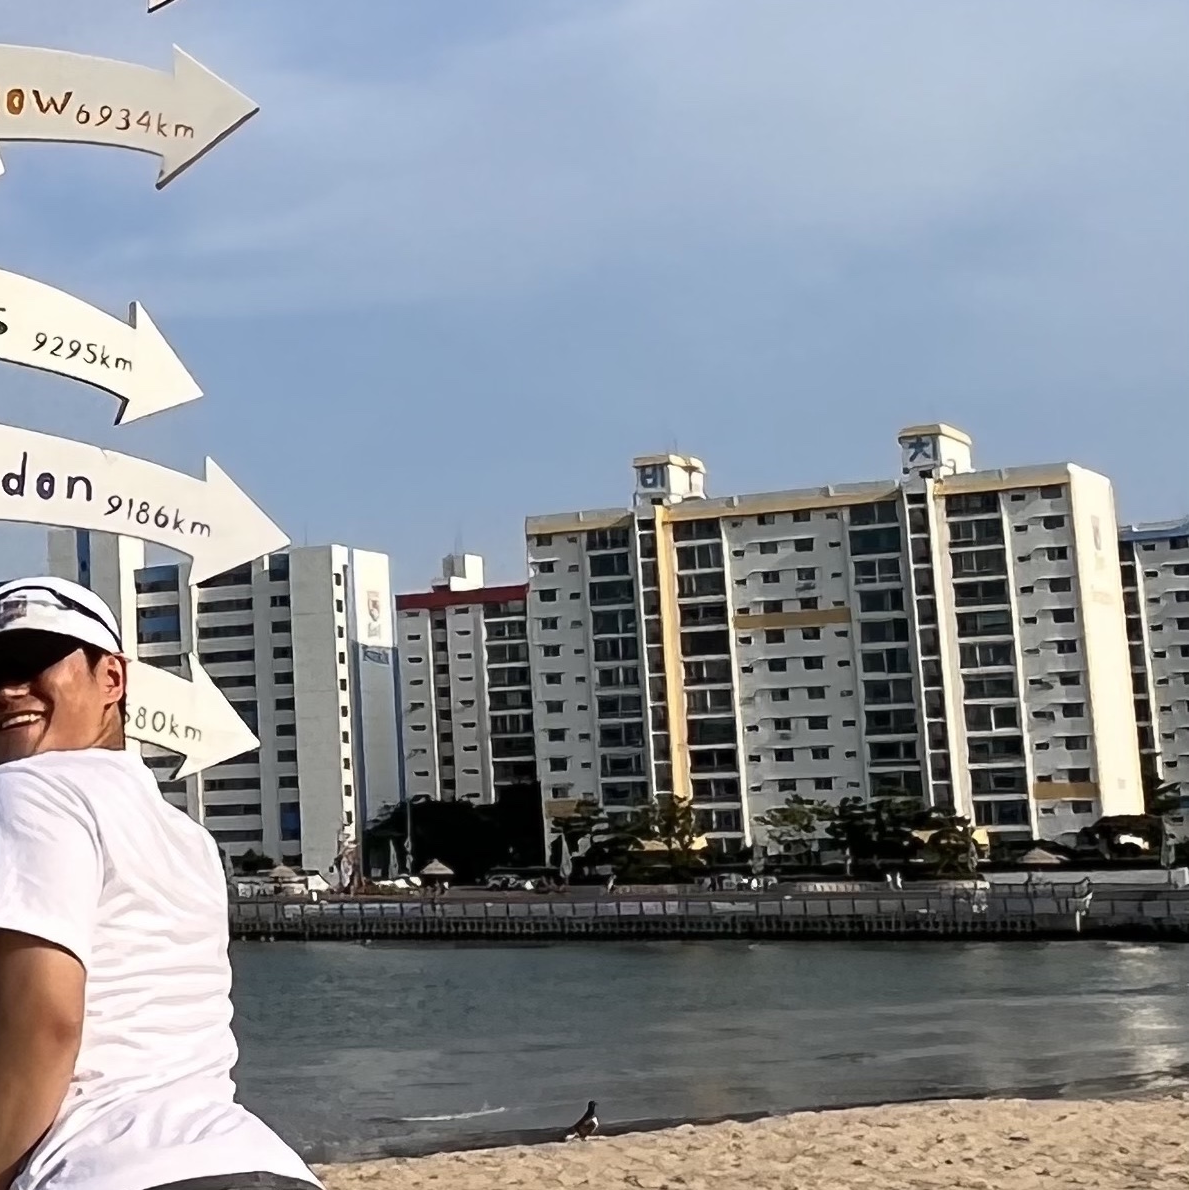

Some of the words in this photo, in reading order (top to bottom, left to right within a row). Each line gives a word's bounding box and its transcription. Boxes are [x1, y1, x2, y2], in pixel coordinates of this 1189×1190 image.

[76, 104, 195, 139] 6934km
[32, 332, 133, 372] 9295km
[103, 495, 211, 537] 9186km
